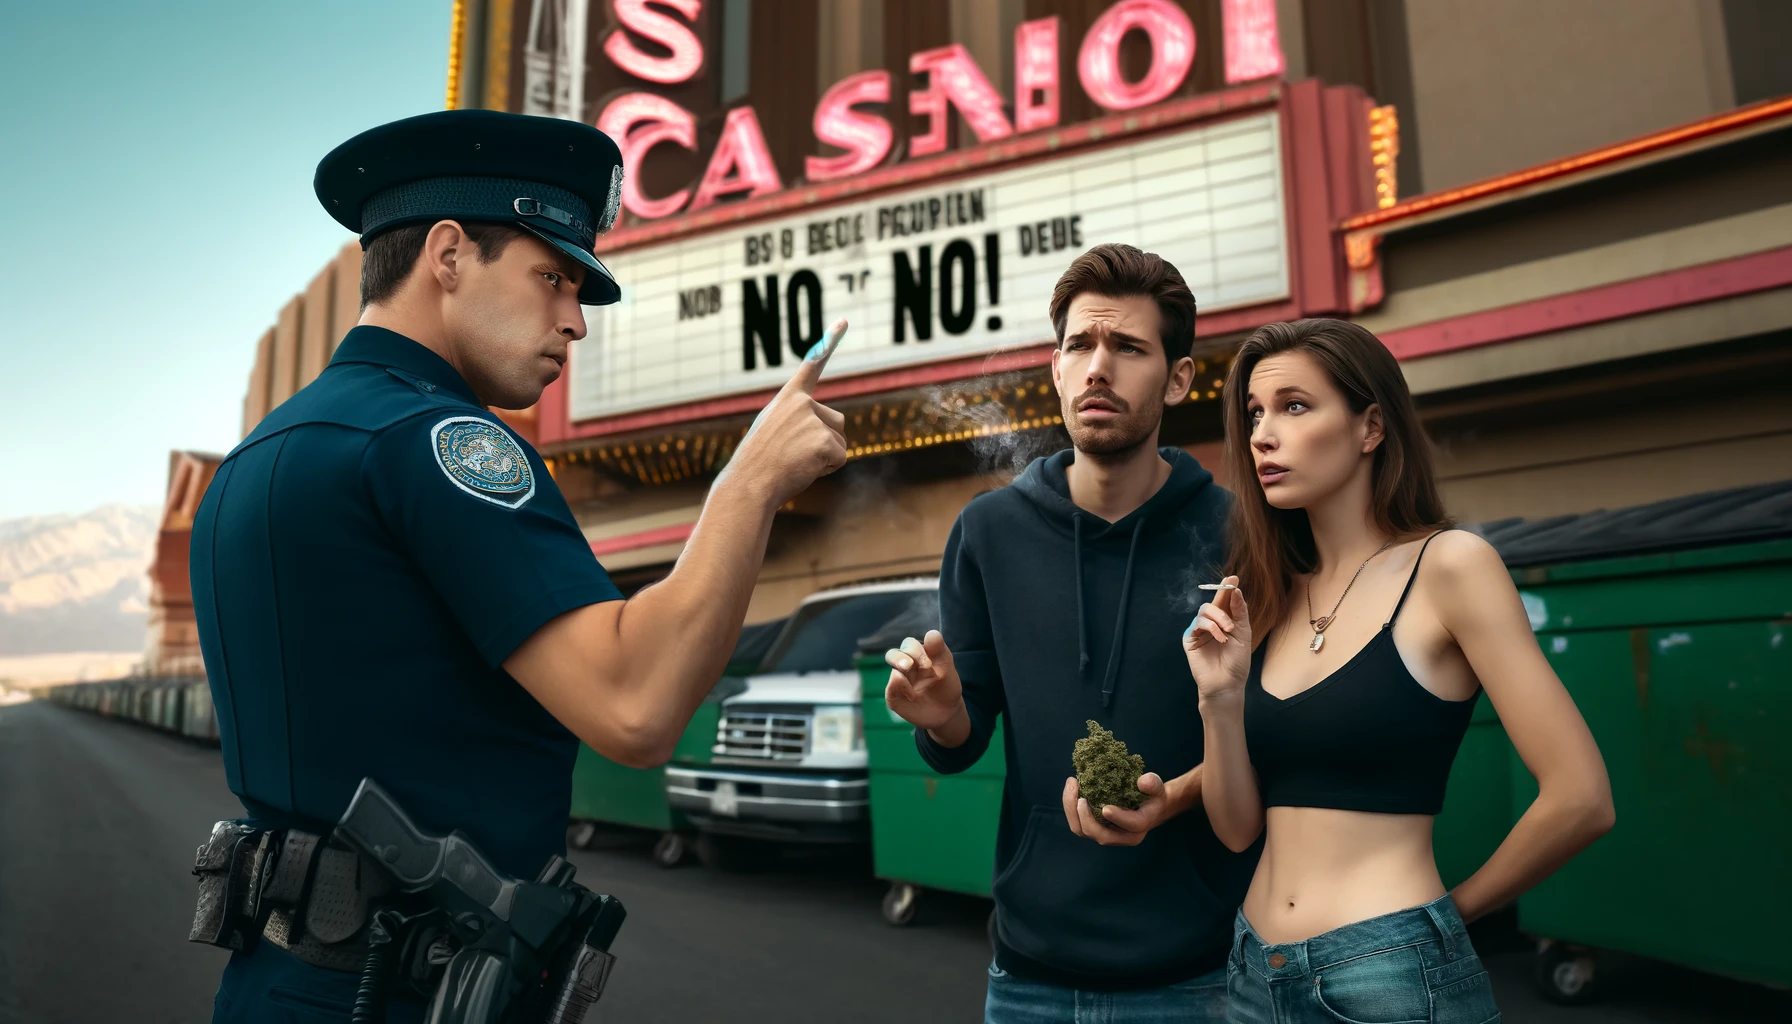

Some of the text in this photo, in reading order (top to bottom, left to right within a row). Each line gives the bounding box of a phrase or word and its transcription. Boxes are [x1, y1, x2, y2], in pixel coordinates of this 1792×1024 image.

[604, 0, 704, 84] S
[742, 268, 824, 372] NO
[892, 232, 1003, 344] NO!
